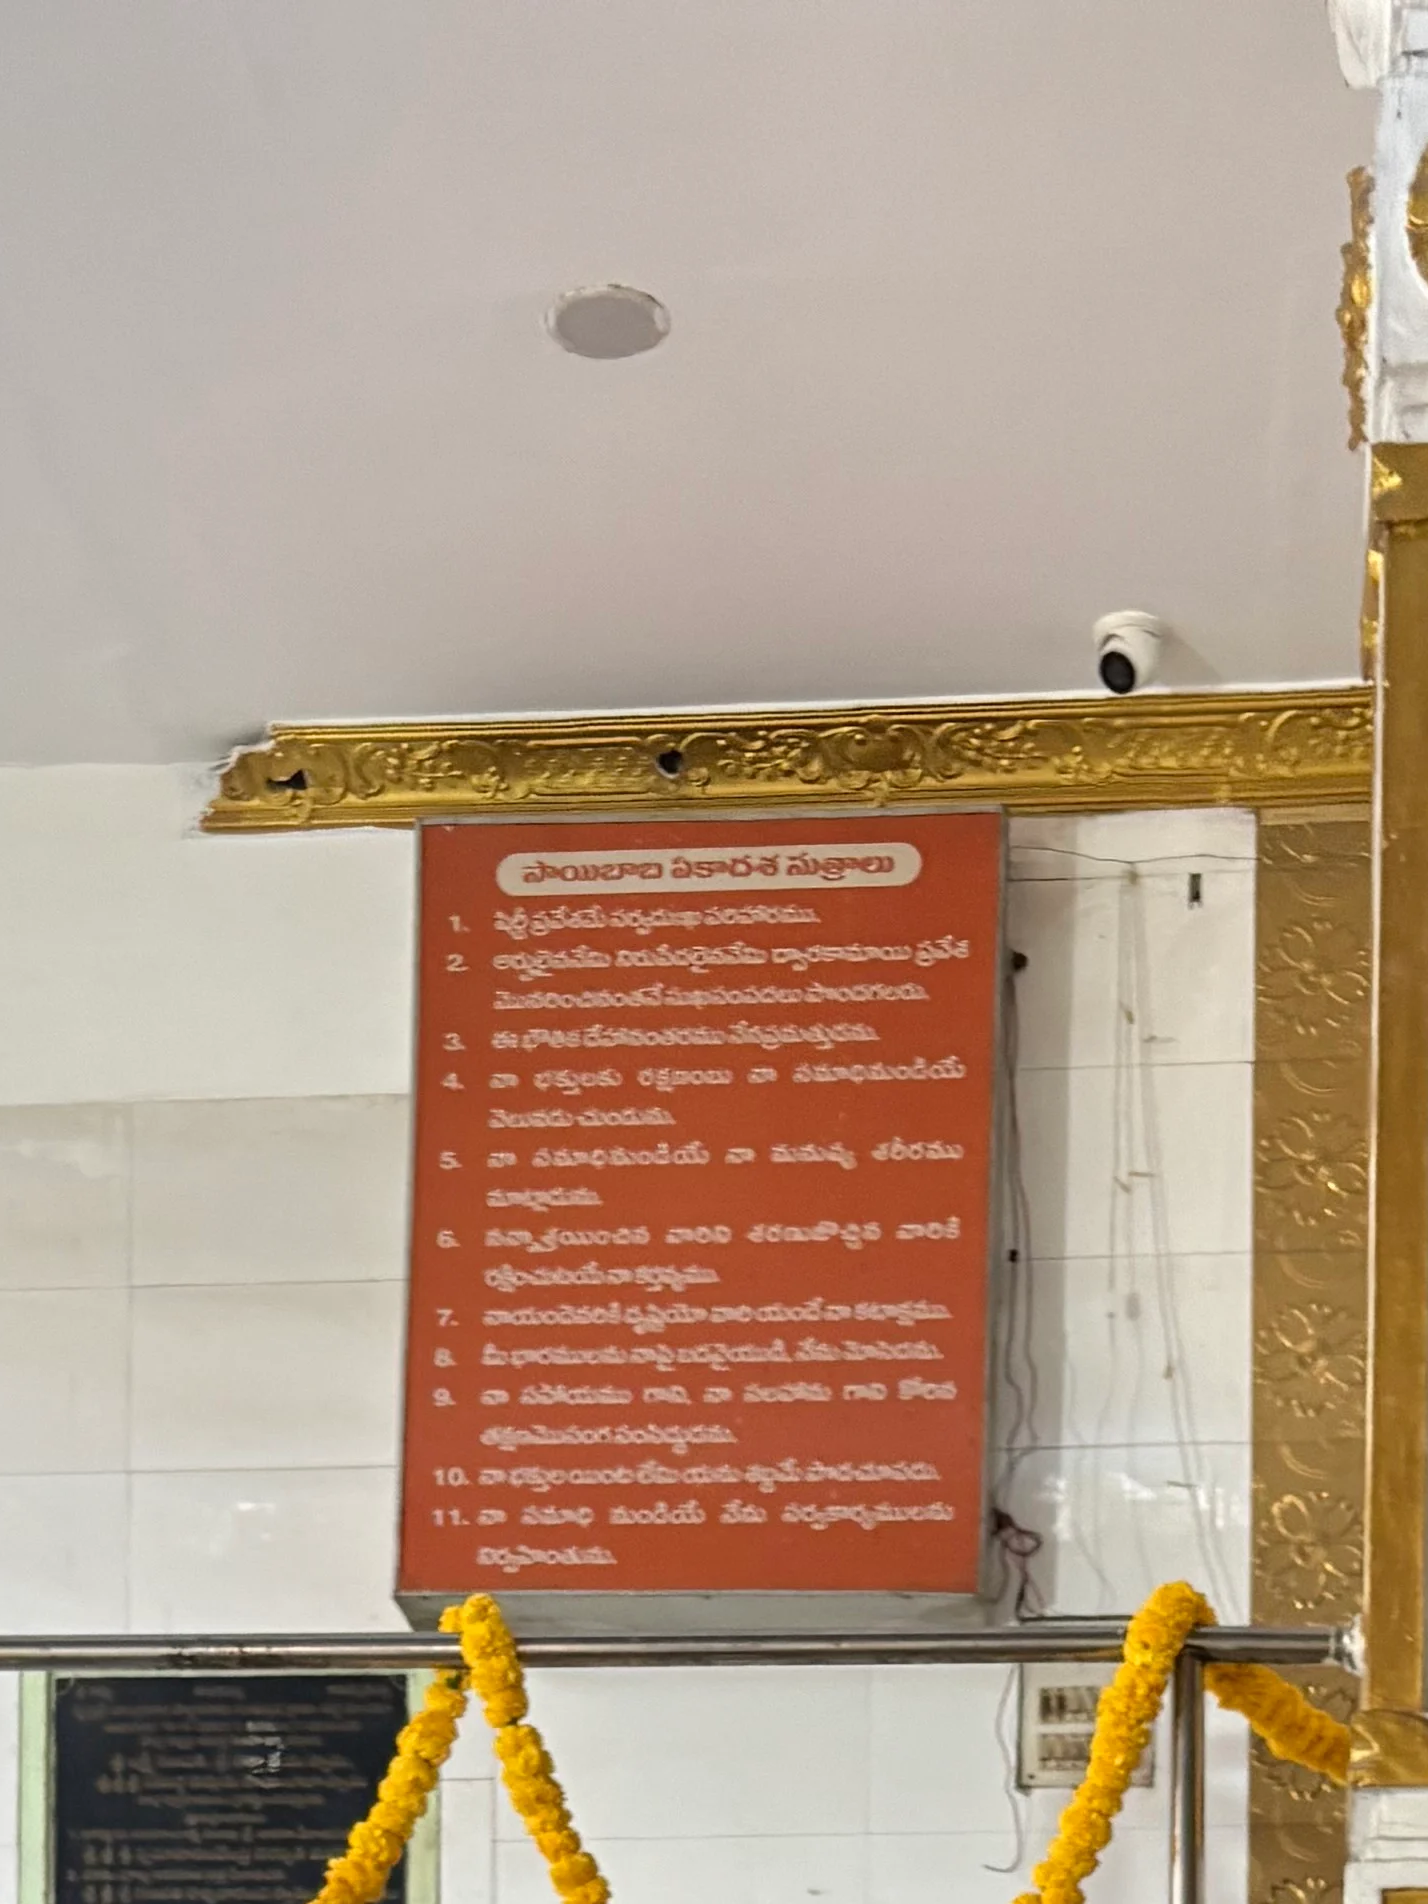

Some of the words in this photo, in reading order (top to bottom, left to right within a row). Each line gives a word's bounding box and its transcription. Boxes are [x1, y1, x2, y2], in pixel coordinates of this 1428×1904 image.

[449, 916, 468, 931] 1.
[490, 1073, 519, 1088] నా
[748, 1067, 777, 1083] నా
[440, 1151, 462, 1170] 5.
[487, 1152, 517, 1168] నా
[725, 1148, 755, 1164] నా
[436, 1230, 460, 1248] 6.
[436, 1308, 458, 1327] 7.
[480, 1389, 510, 1405] నా
[703, 1386, 733, 1404] నా
[433, 1467, 470, 1487] 10.
[432, 1508, 470, 1526] 11.
[477, 1509, 507, 1525] నా
